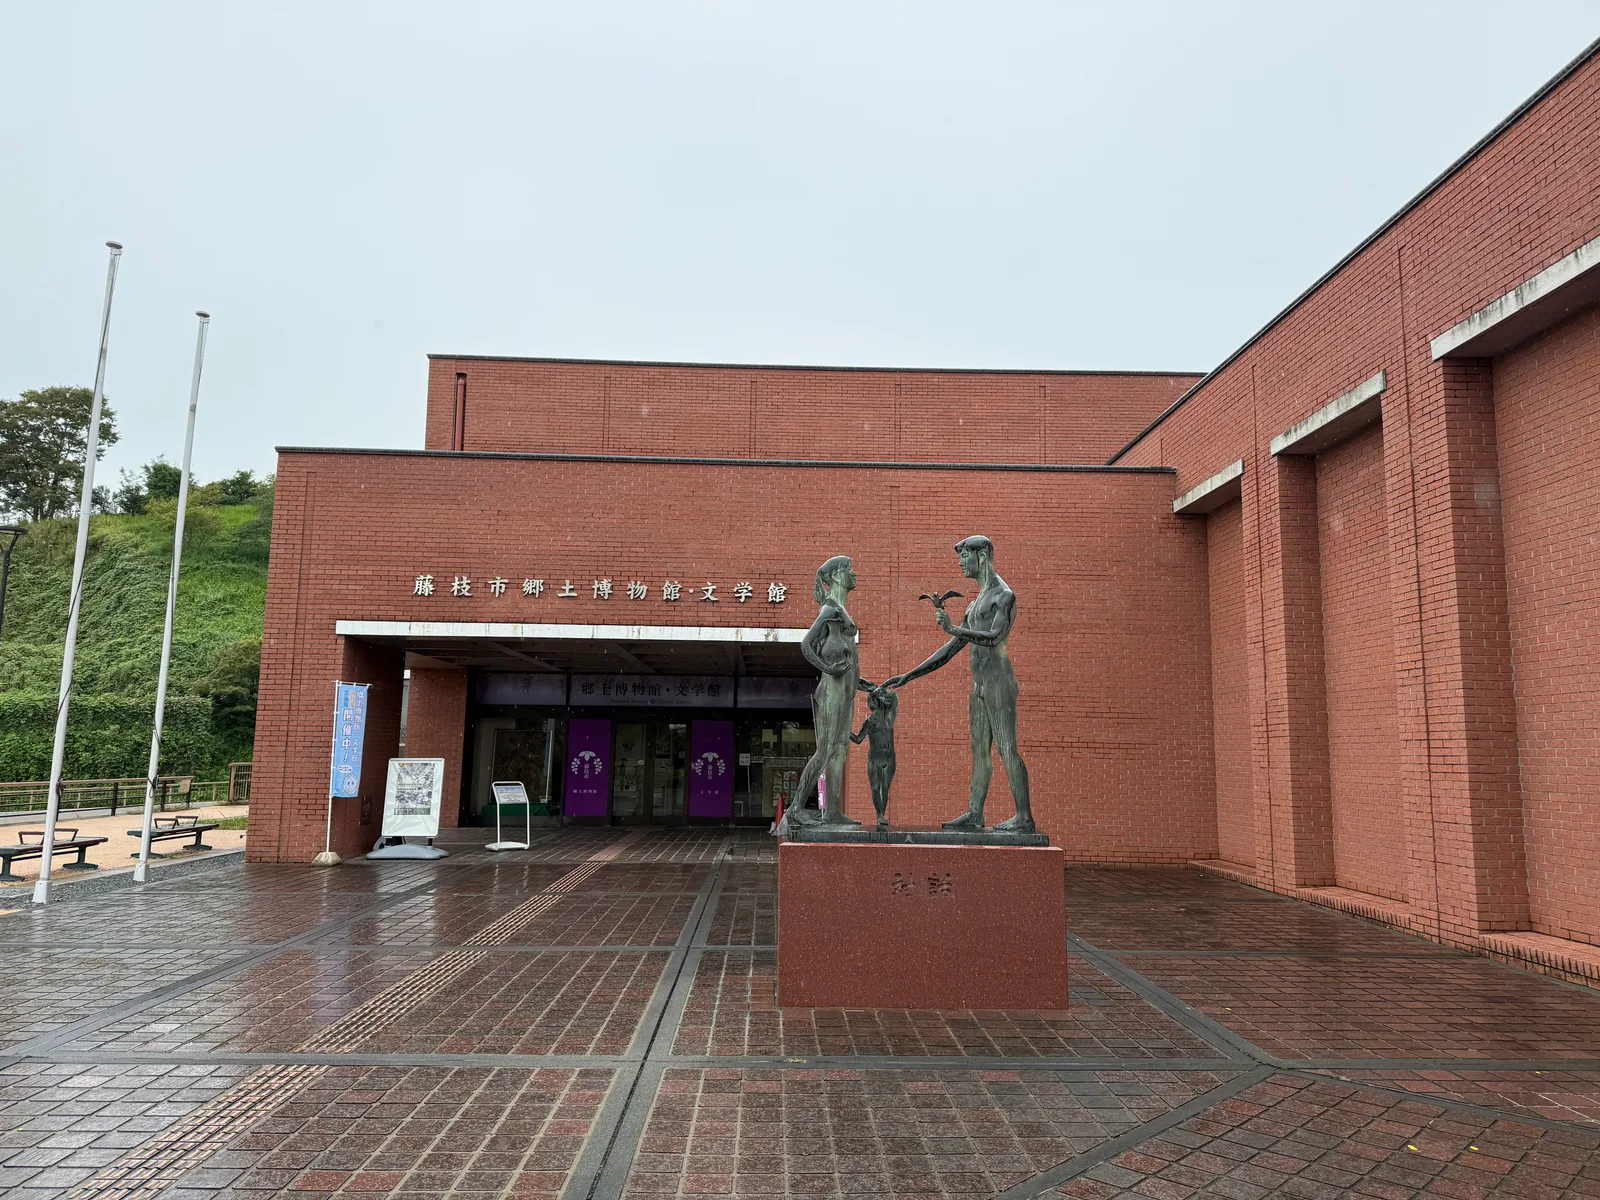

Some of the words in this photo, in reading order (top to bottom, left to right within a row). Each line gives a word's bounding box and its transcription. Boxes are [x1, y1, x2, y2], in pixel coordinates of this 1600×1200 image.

[412, 574, 788, 603] 藤枝市郷土博物館・文学館
[581, 682, 722, 697] 郷土博物館・文学館
